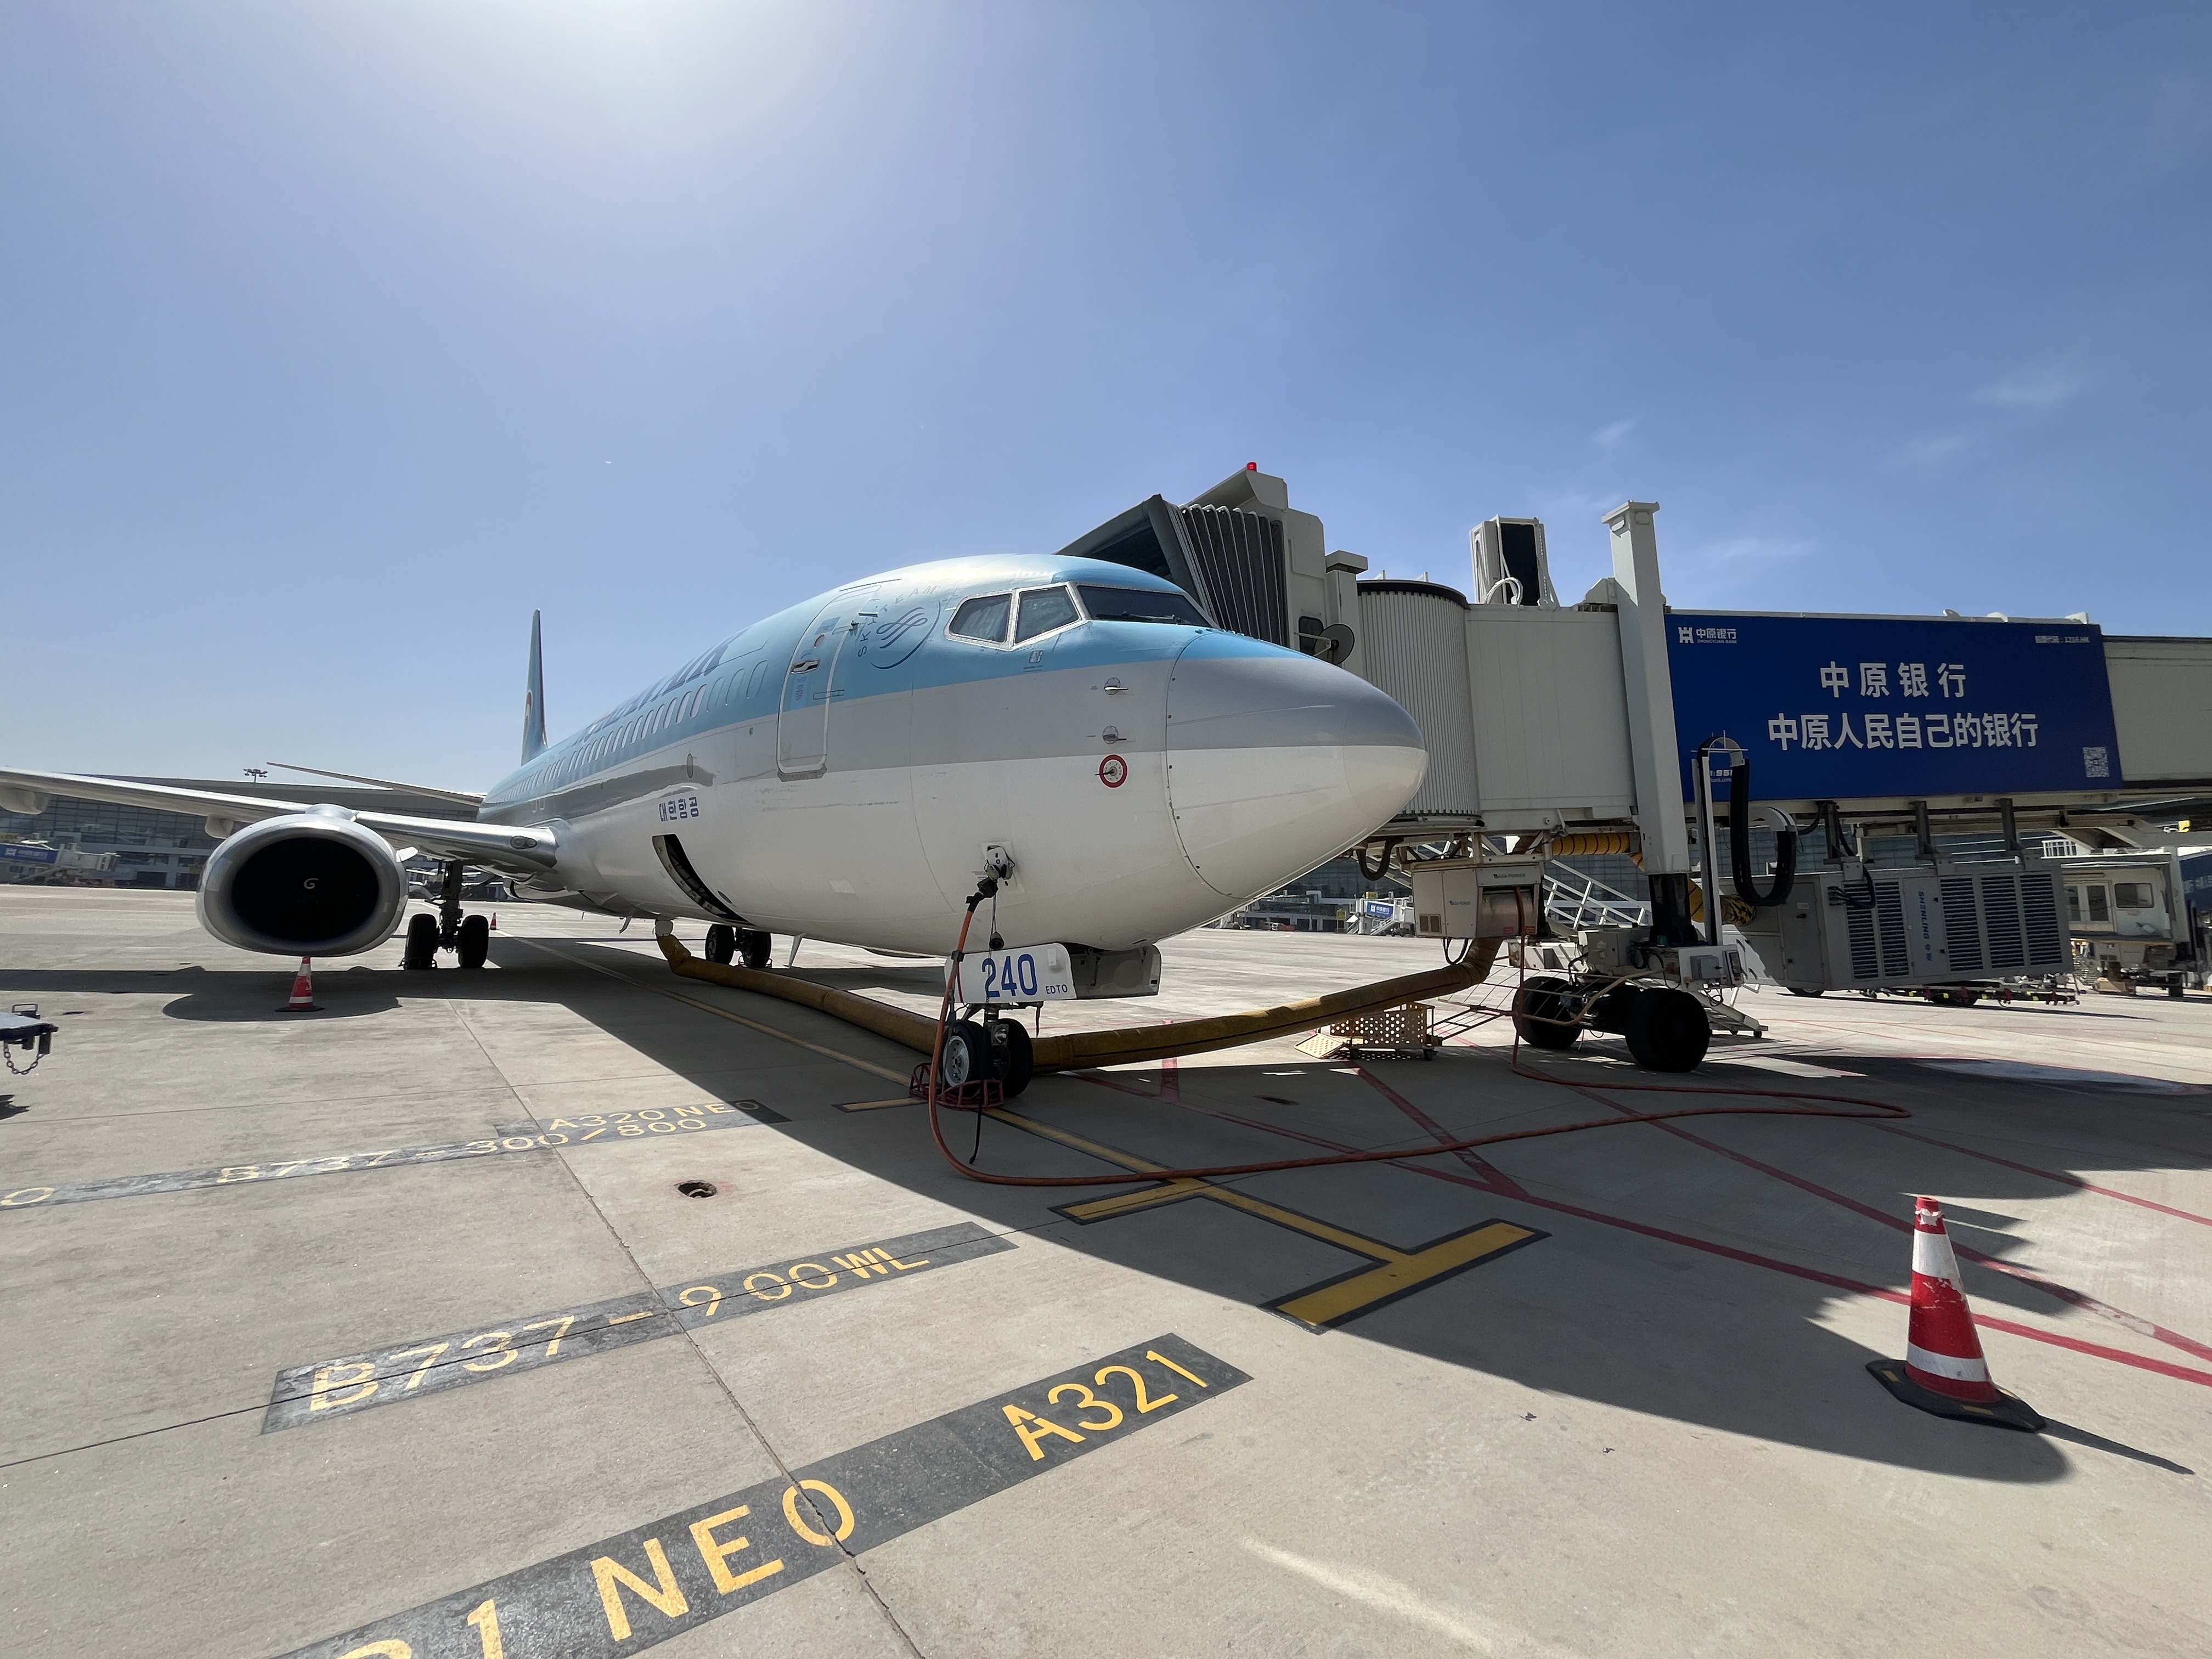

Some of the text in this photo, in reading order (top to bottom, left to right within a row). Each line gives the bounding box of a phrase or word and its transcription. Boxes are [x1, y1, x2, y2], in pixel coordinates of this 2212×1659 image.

[1696, 628, 1736, 639] 中原银行
[1820, 661, 1966, 698] 中原银行
[1768, 713, 2039, 750] 中原人民自己的银行
[659, 797, 699, 822] 대한항공
[1918, 891, 1929, 939] SHENLING
[982, 953, 1038, 997] 240
[1045, 984, 1068, 994] EDTO
[590, 1480, 855, 1642] NEO
[1002, 1350, 1208, 1461] A321
